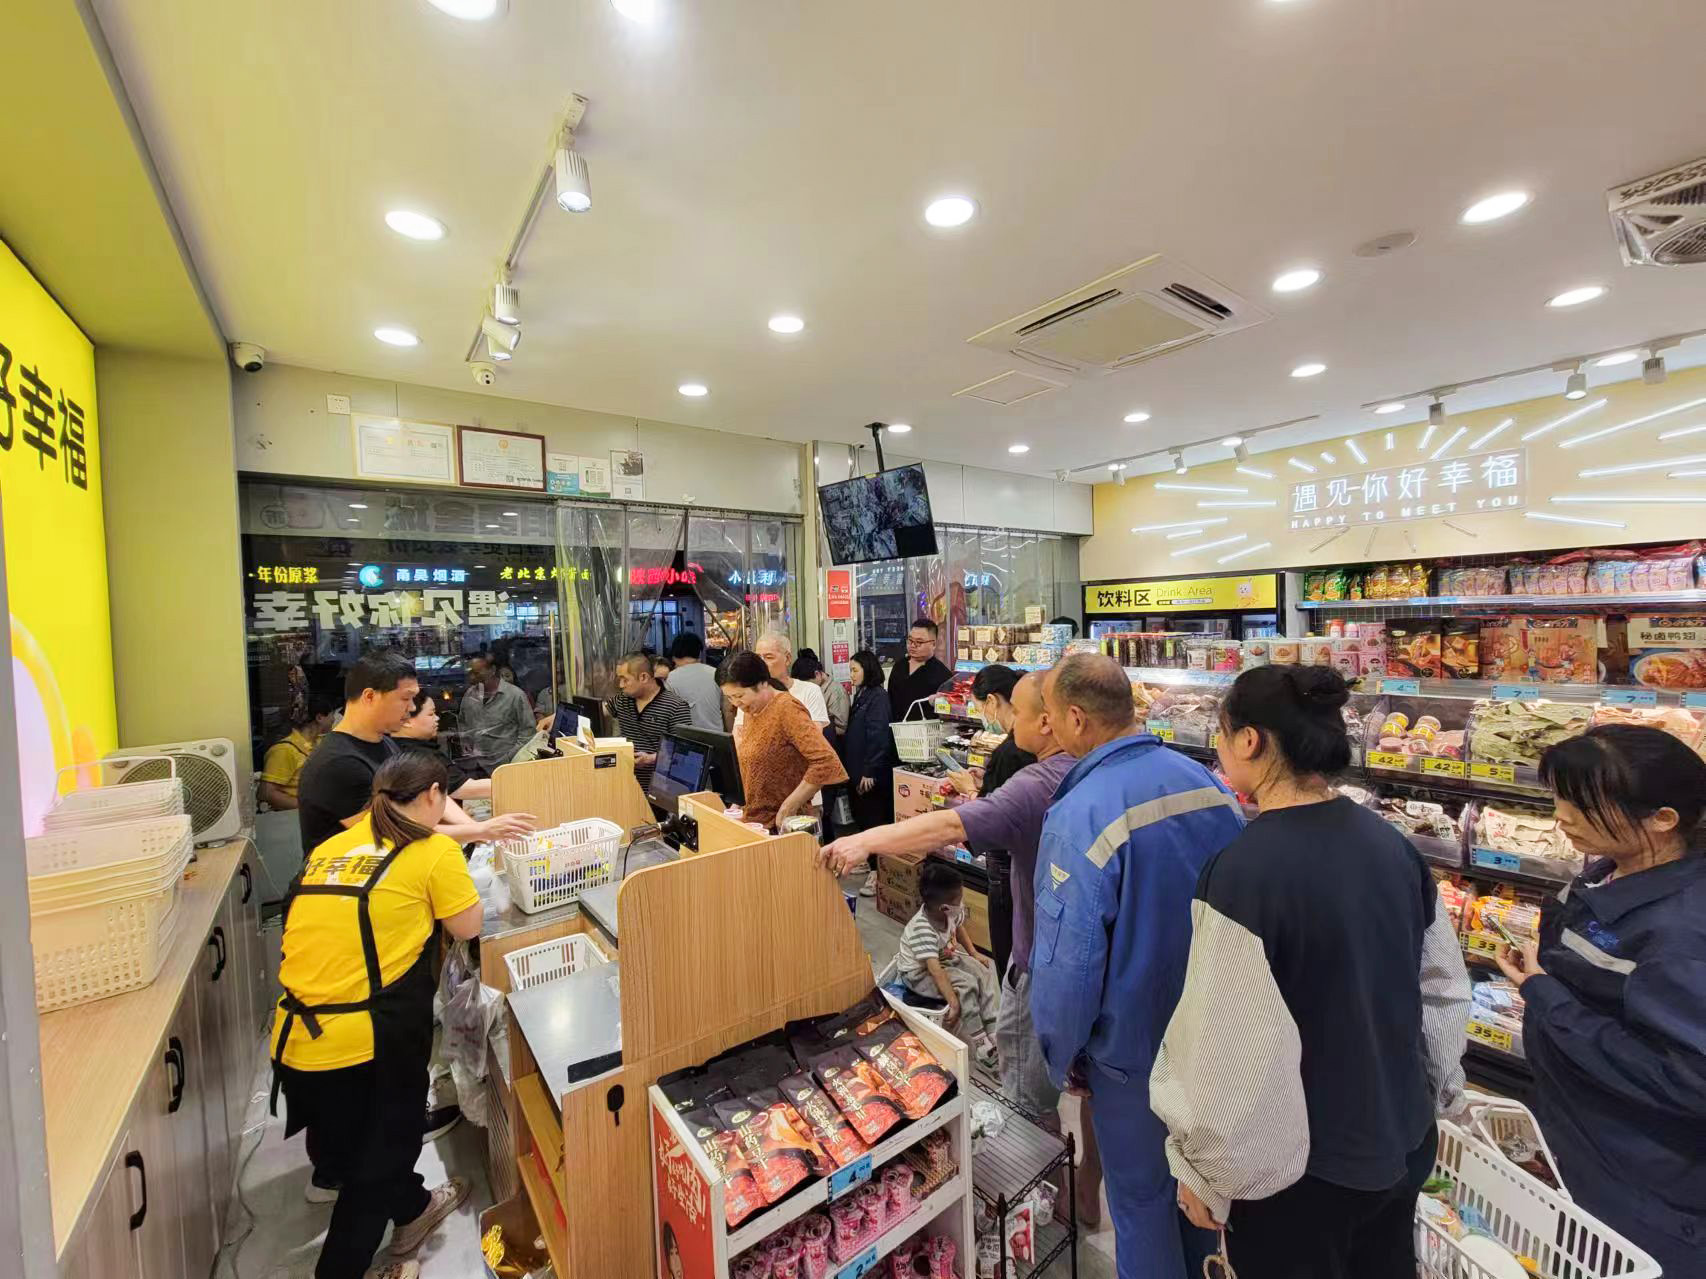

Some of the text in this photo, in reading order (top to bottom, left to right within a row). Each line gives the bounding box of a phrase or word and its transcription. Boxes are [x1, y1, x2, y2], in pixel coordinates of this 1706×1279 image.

[1291, 496, 1518, 529] HAPPY TO MEET YOU
[257, 566, 320, 584] 年份原浆
[1156, 586, 1212, 597] Drink Area
[1097, 589, 1151, 607] 饮料区
[1378, 755, 1393, 765] 42
[1434, 763, 1450, 771] 42
[1478, 940, 1497, 951] 33
[1474, 1025, 1492, 1038] 35
